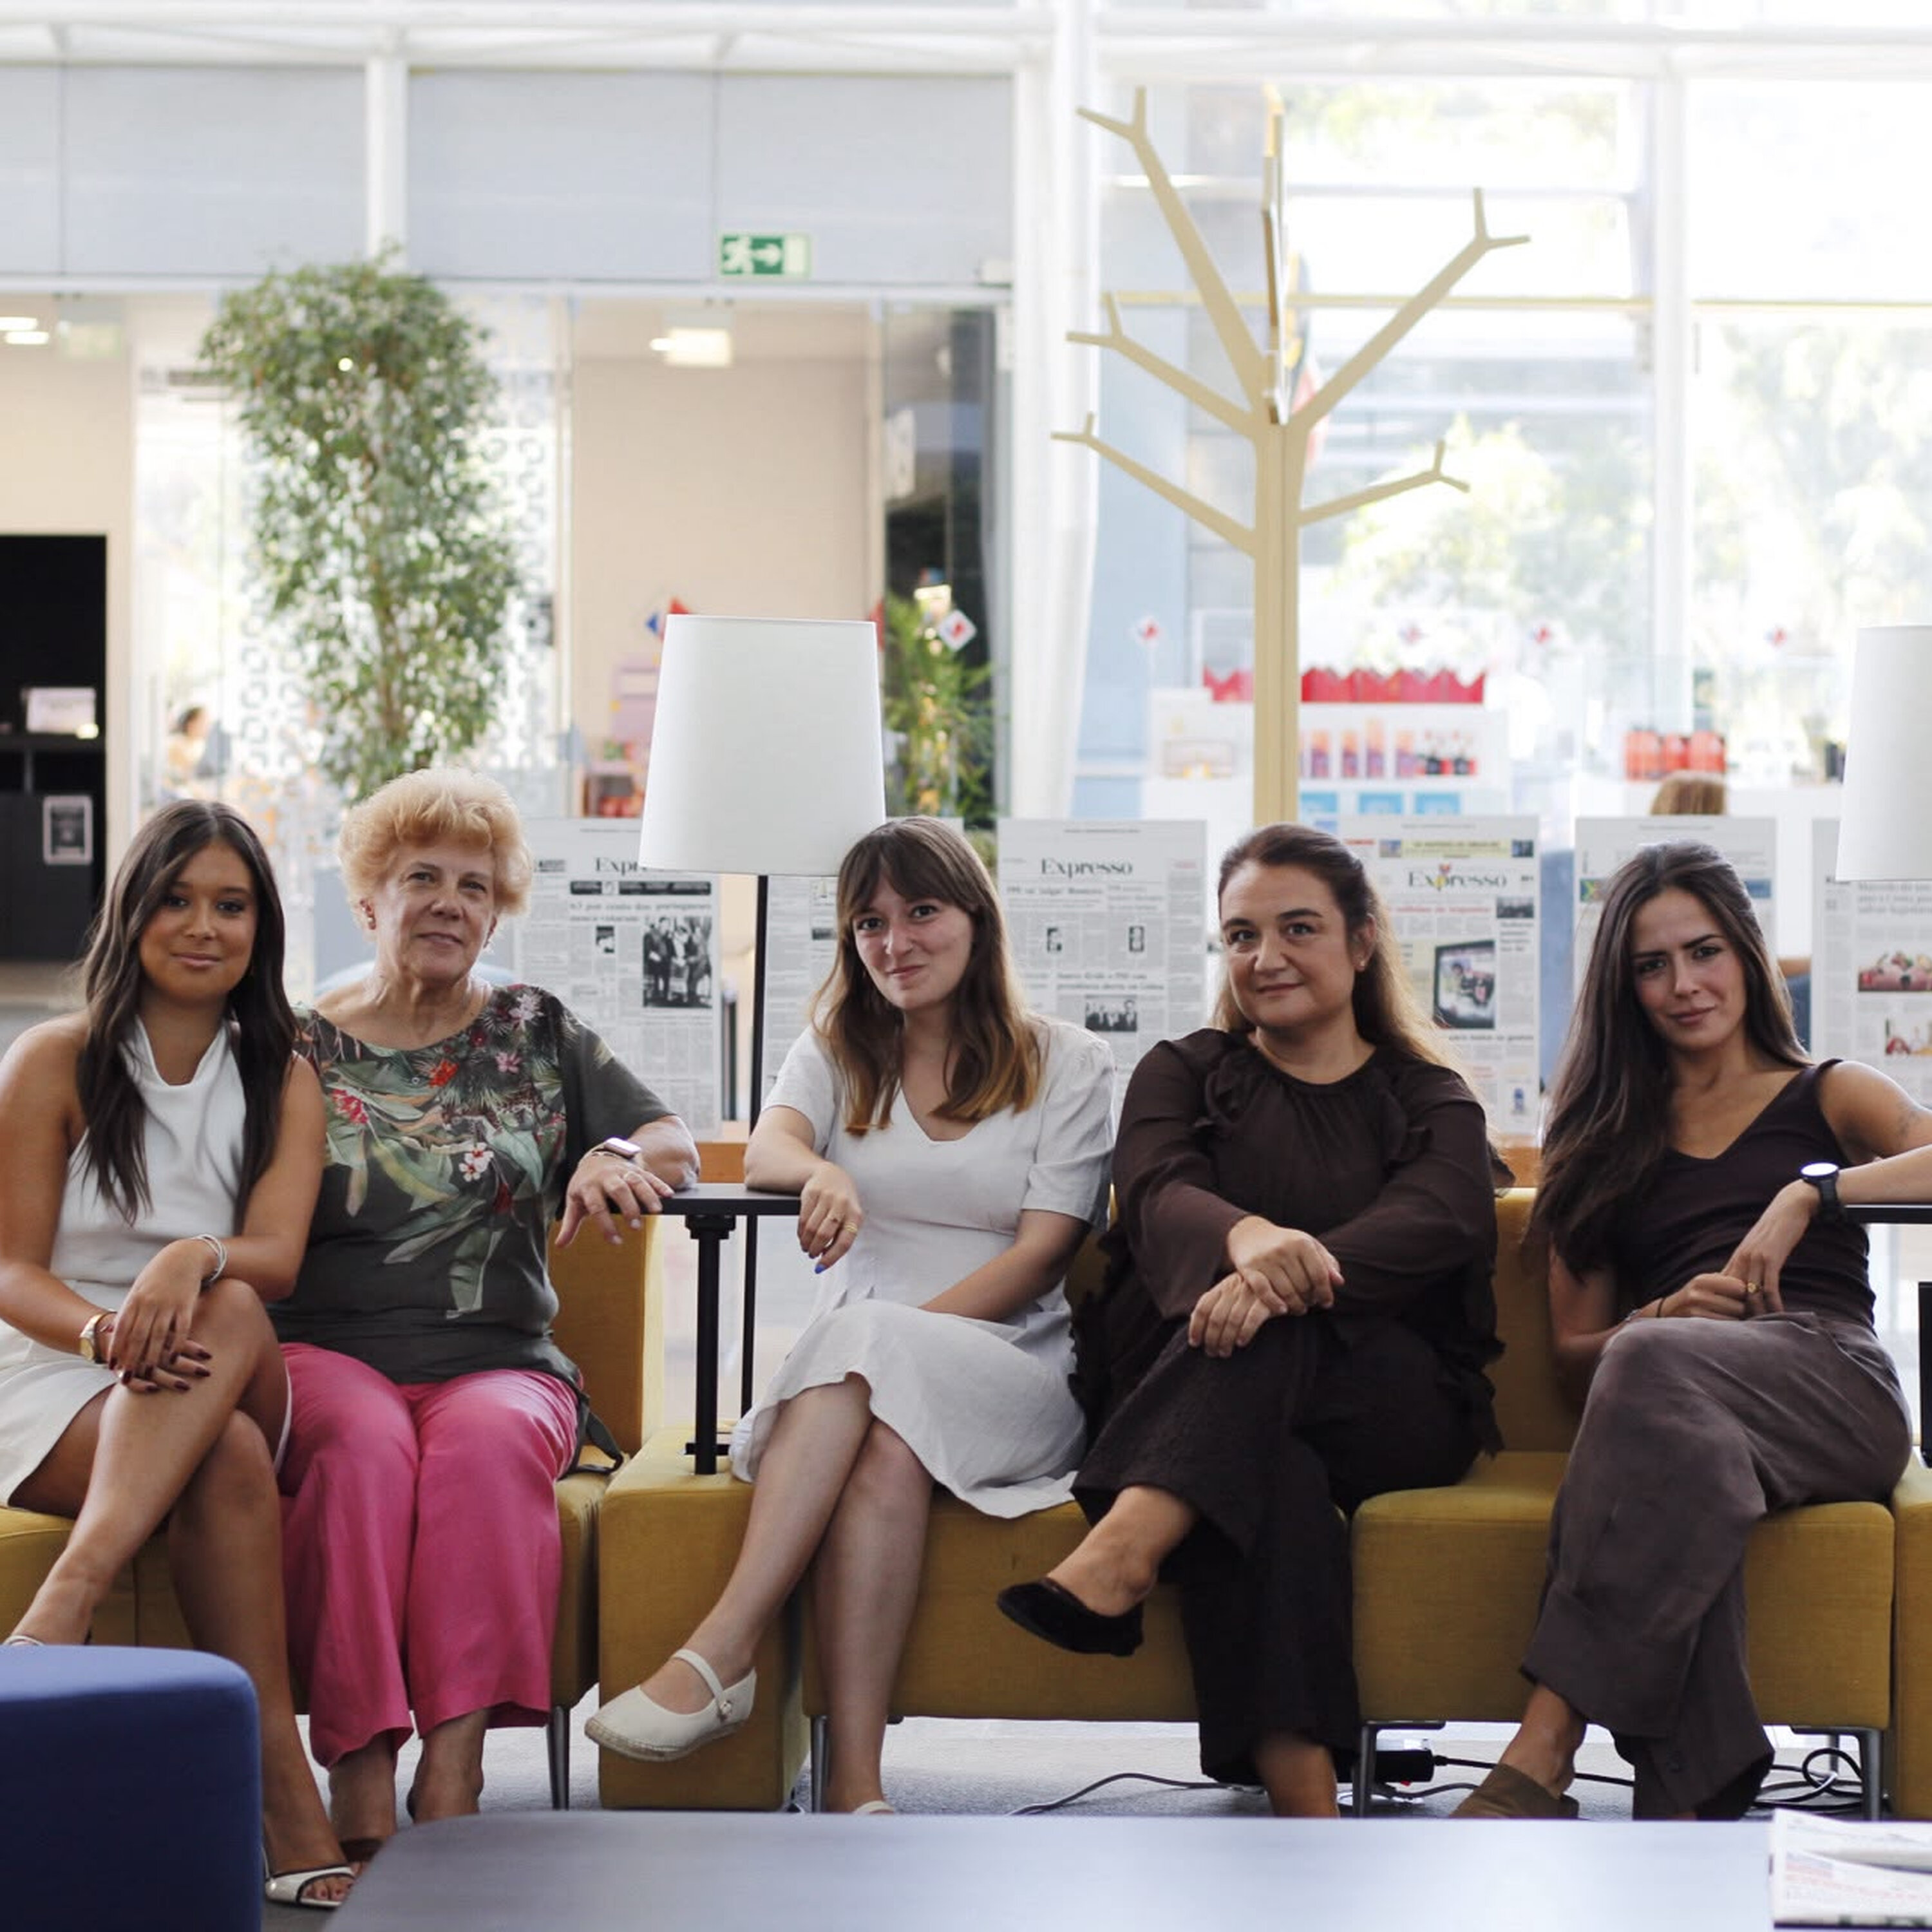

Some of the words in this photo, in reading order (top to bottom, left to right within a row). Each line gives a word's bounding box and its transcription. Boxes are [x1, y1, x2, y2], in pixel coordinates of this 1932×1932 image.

[595, 857, 647, 876] Expr
[1041, 857, 1133, 878] Expresso
[1408, 871, 1507, 891] Expresso
